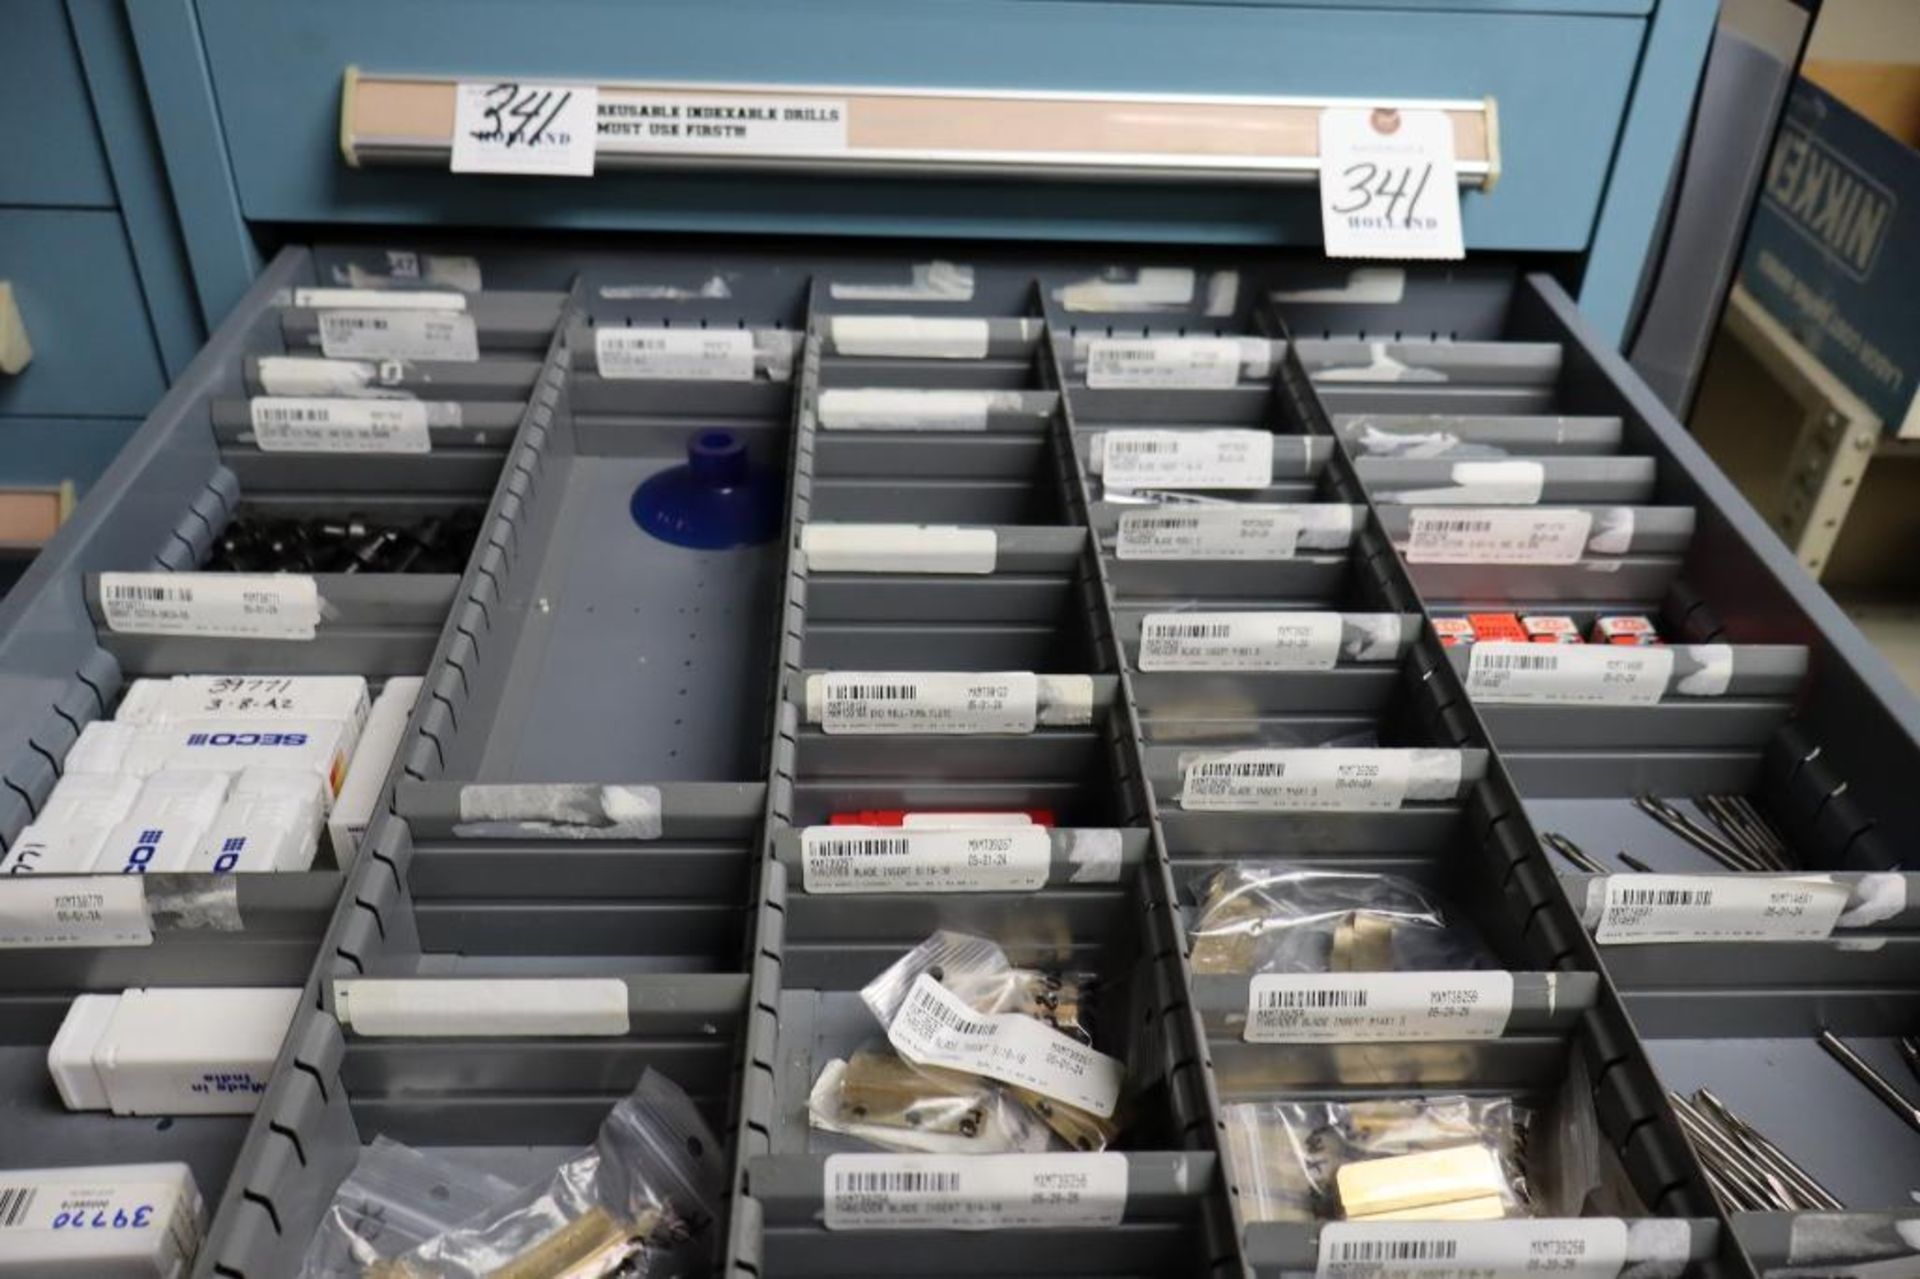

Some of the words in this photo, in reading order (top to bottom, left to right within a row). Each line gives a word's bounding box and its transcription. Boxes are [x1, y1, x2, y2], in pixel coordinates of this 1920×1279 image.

[469, 83, 571, 147] 341
[596, 104, 680, 118] REUSABLE
[687, 106, 777, 120] INDEXABLE
[784, 108, 839, 121] DRILLS
[596, 122, 643, 135] MUST
[649, 123, 680, 135] USE
[1331, 161, 1433, 229] 341
[209, 733, 308, 746] SECO
[53, 1205, 154, 1229] 39770
